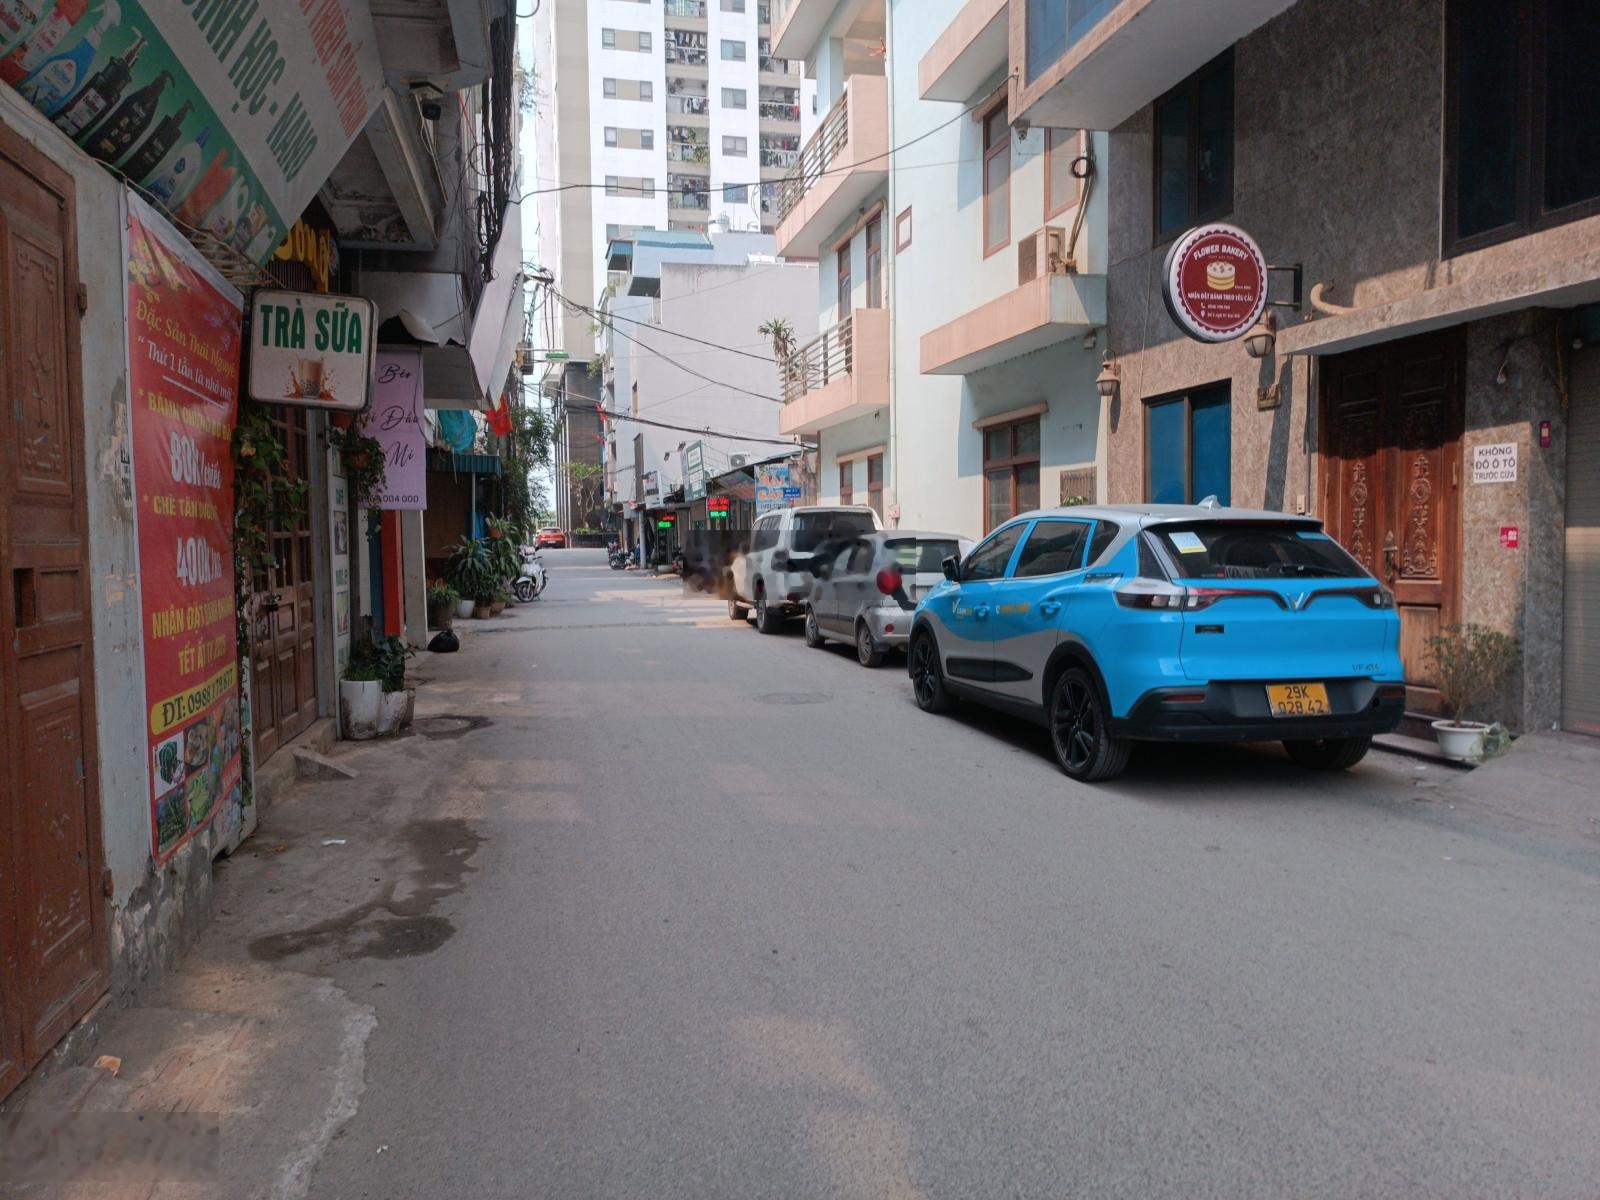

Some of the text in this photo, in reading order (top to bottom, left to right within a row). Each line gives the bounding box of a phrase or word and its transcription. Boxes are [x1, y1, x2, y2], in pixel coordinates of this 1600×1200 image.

[228, 18, 286, 115] HỌC
[265, 92, 318, 182] NANO
[1193, 244, 1249, 261] FLOWER BAKERY
[136, 299, 163, 331] Đặc
[164, 318, 187, 347] Sản
[260, 298, 362, 354] TRÀ SỮA
[170, 352, 176, 372] 1
[177, 356, 193, 380] lần
[195, 367, 205, 387] là
[148, 391, 181, 420] BÁNH
[1478, 446, 1512, 457] KHÔNG
[1492, 458, 1499, 469] Ô
[1503, 457, 1516, 468] TÔ
[1475, 470, 1515, 480] TRƯỚC CỬA
[153, 494, 176, 516] CHÈ
[383, 495, 400, 503] 004
[402, 494, 419, 503] 000
[152, 603, 184, 640] NHẬN
[186, 600, 205, 634] ĐẶT
[178, 640, 195, 676] TẾT
[1284, 686, 1310, 699] 29K
[162, 695, 186, 728] ĐT:
